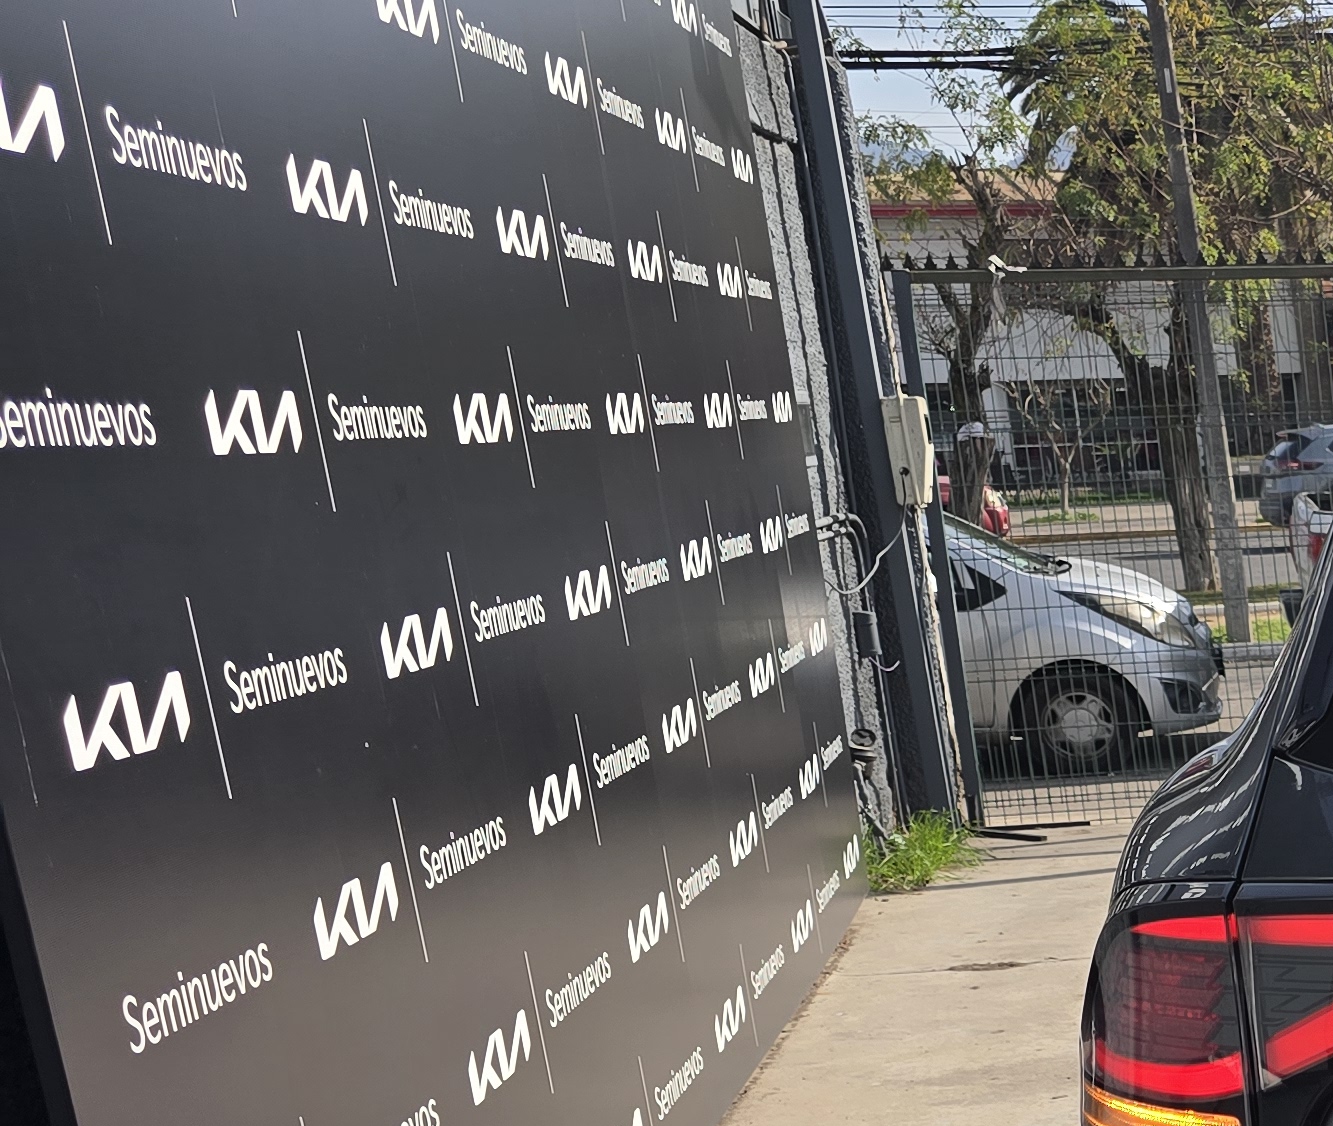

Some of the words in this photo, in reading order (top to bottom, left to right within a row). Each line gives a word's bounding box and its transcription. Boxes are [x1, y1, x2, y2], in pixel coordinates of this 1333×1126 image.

[456, 9, 527, 75] Seminuevos
[545, 52, 587, 108] KIA
[105, 106, 247, 191] Seminuevos
[655, 108, 686, 154] KIA
[286, 153, 368, 226] KIA
[389, 180, 474, 239] Seminuevos
[496, 206, 549, 261] KIA
[628, 239, 663, 283] KIA
[205, 389, 302, 455] KIA
[328, 393, 427, 441] Seminuevos
[453, 393, 513, 444] KIA
[527, 395, 591, 432] Seminuevos
[606, 393, 644, 434] KIA
[680, 537, 712, 581] KIA
[565, 565, 611, 620] KIA
[381, 607, 453, 679] KIA
[470, 595, 545, 642] Seminuevos
[63, 671, 190, 771] KIA
[224, 648, 347, 713] Seminuevos
[662, 698, 696, 753] KIA
[529, 764, 581, 835] KIA
[729, 811, 759, 868] KIA
[314, 862, 398, 960] KIA
[420, 817, 506, 889] Seminuevos
[628, 891, 668, 963] KIA
[123, 943, 272, 1053] Seminuevos
[468, 1009, 531, 1106] KIA
[546, 952, 611, 1027] Seminuevos
[715, 985, 745, 1052] KIA
